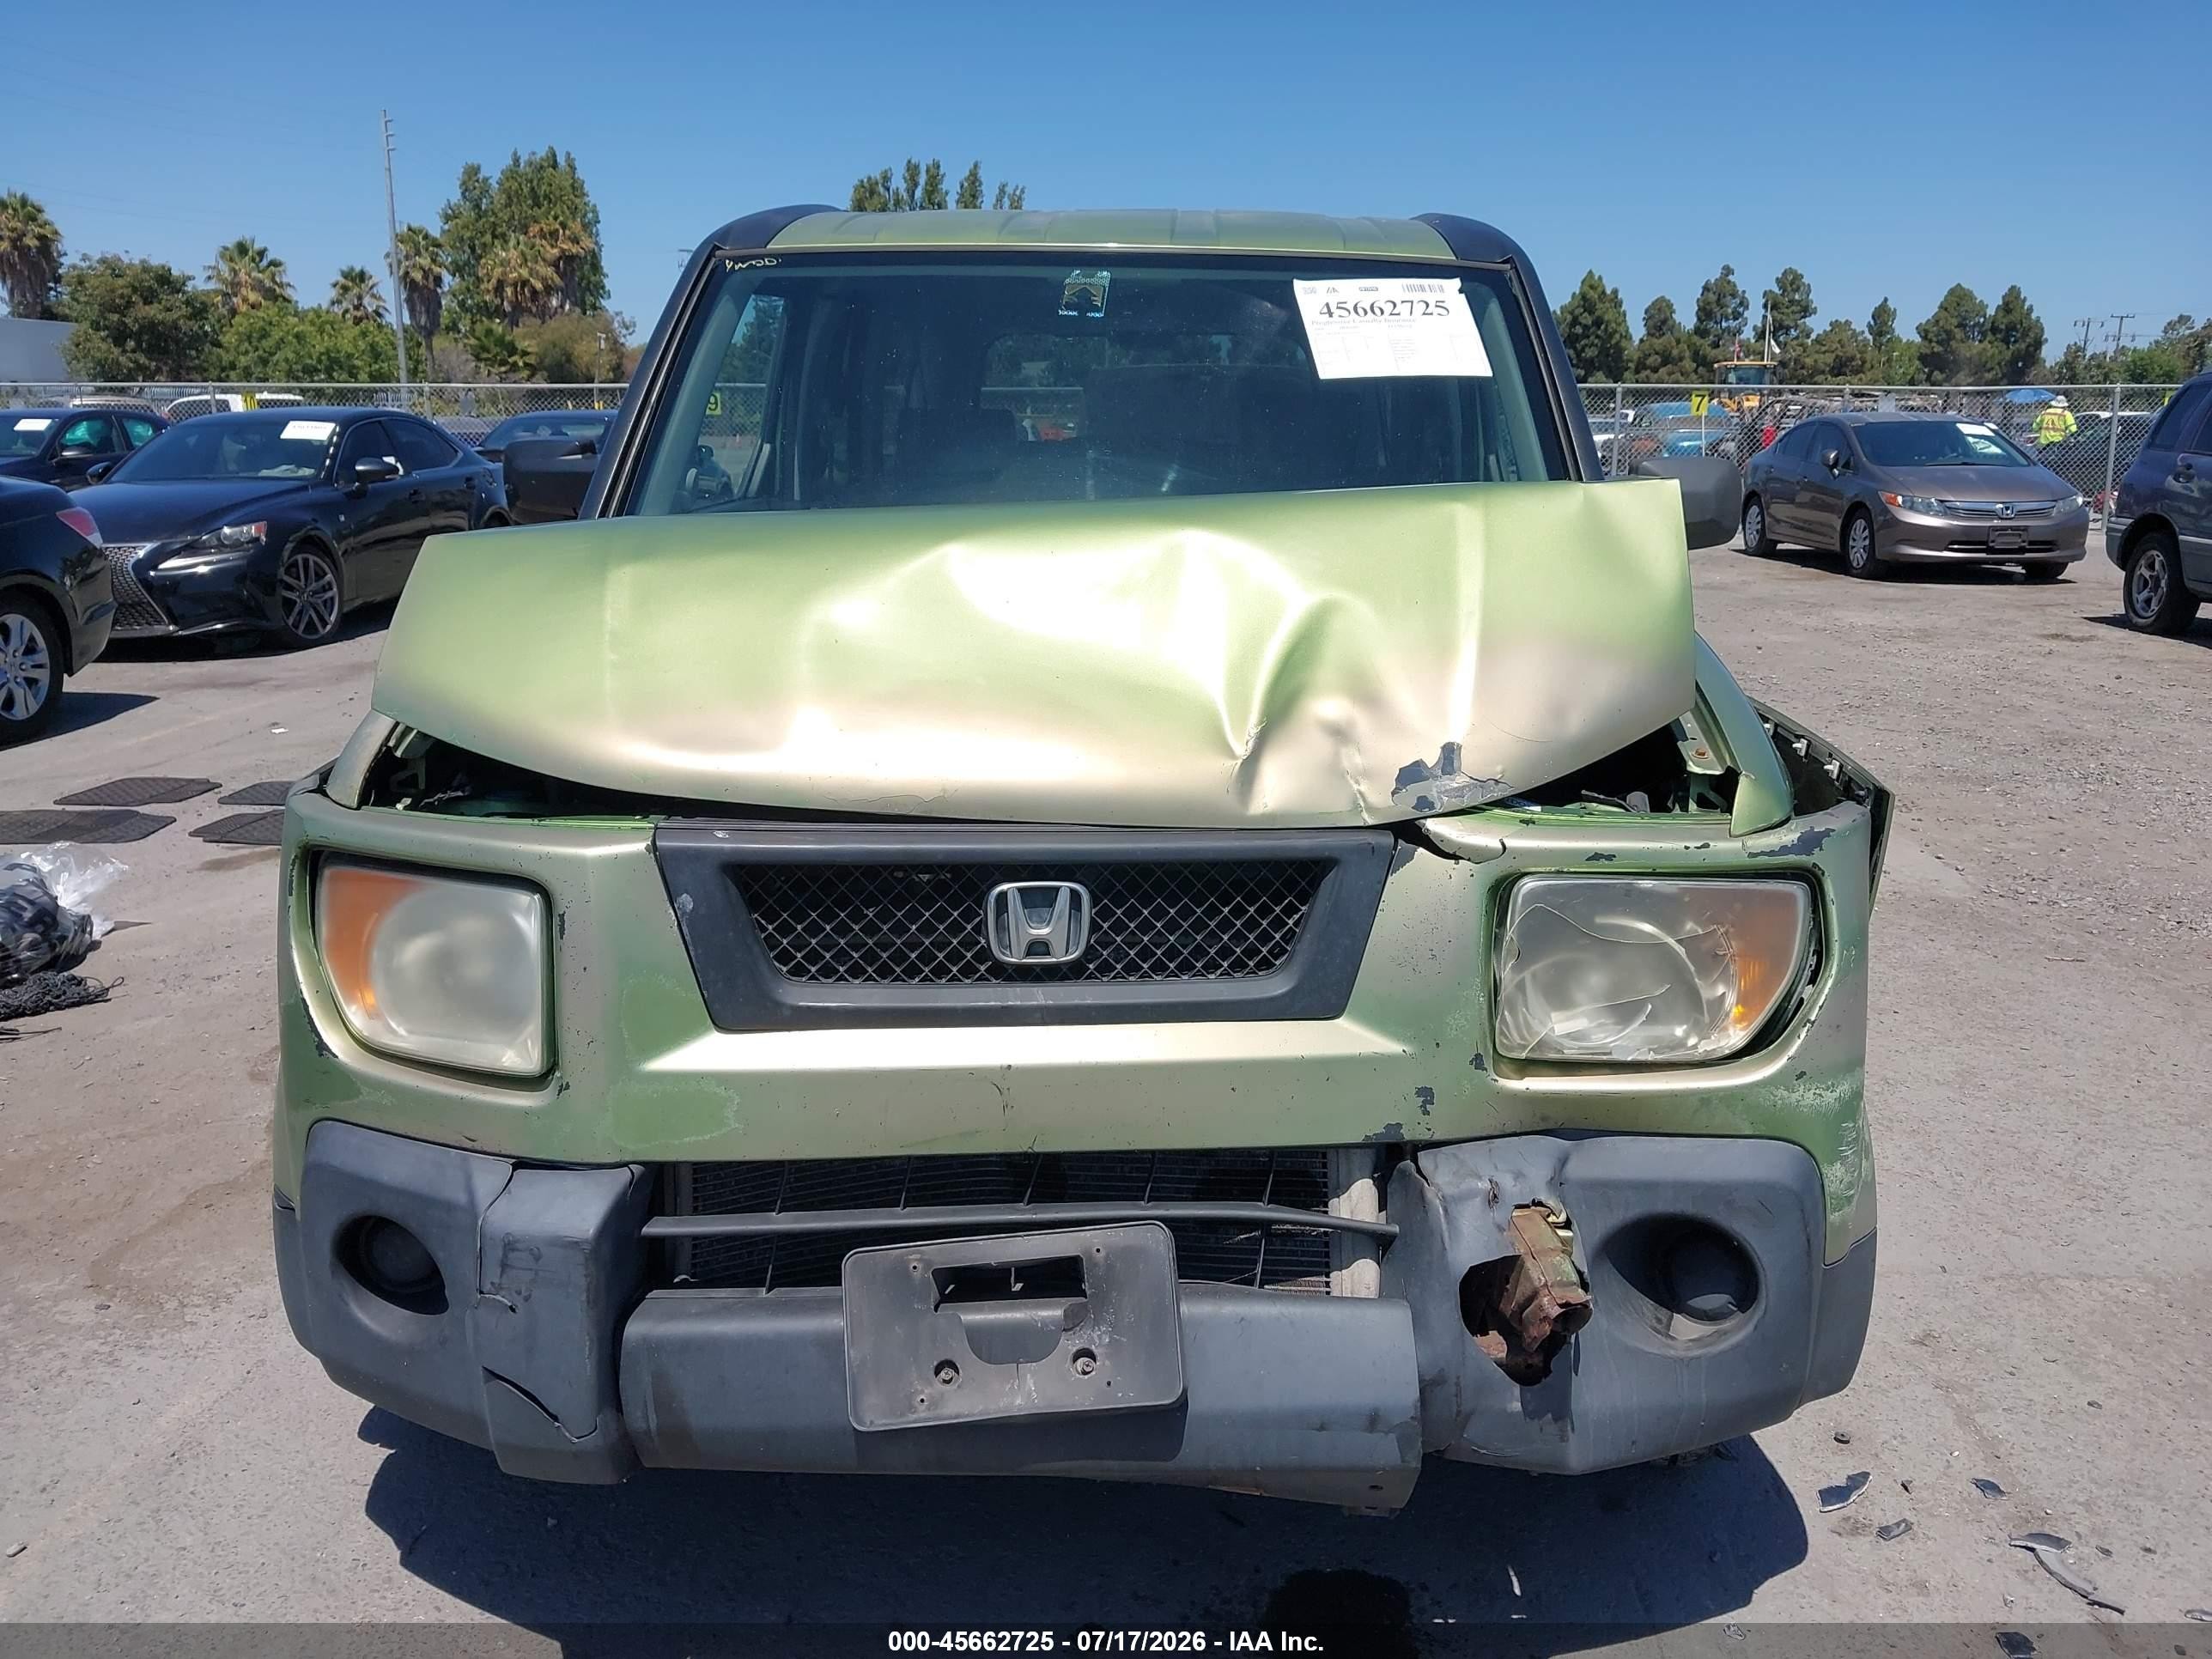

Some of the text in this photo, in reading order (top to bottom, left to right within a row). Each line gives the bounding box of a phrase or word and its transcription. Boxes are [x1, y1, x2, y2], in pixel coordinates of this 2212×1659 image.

[1319, 301, 1449, 318] 45662725
[708, 393, 718, 411] 9
[1694, 394, 1706, 412] 7
